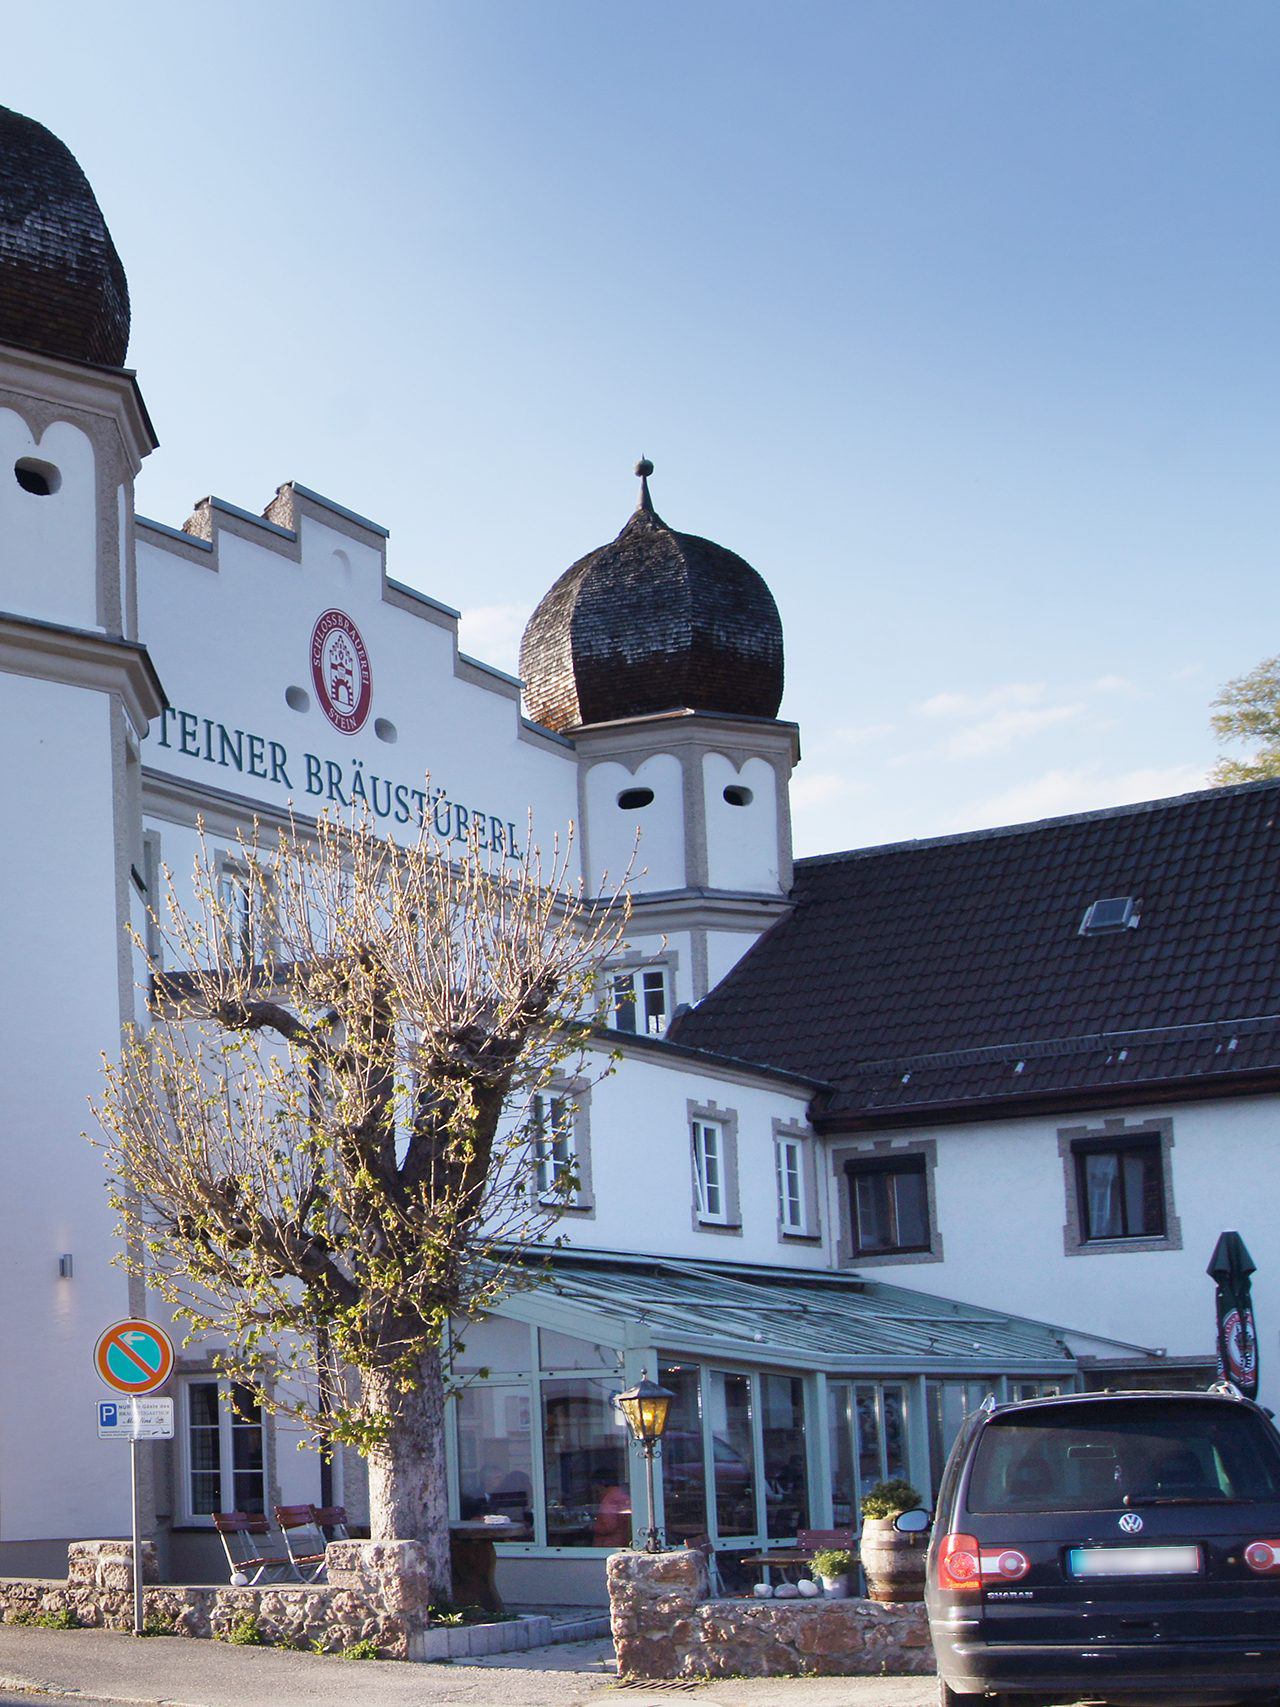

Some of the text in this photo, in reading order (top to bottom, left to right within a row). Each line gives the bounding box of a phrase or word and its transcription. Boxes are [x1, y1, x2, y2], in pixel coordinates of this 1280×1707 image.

[313, 615, 369, 685] SCHLOSSBRAUEREI
[328, 708, 357, 730] STEIN
[141, 707, 523, 861] TEINER BRÄUSTÜBERL
[986, 1591, 1034, 1599] SHARAN
